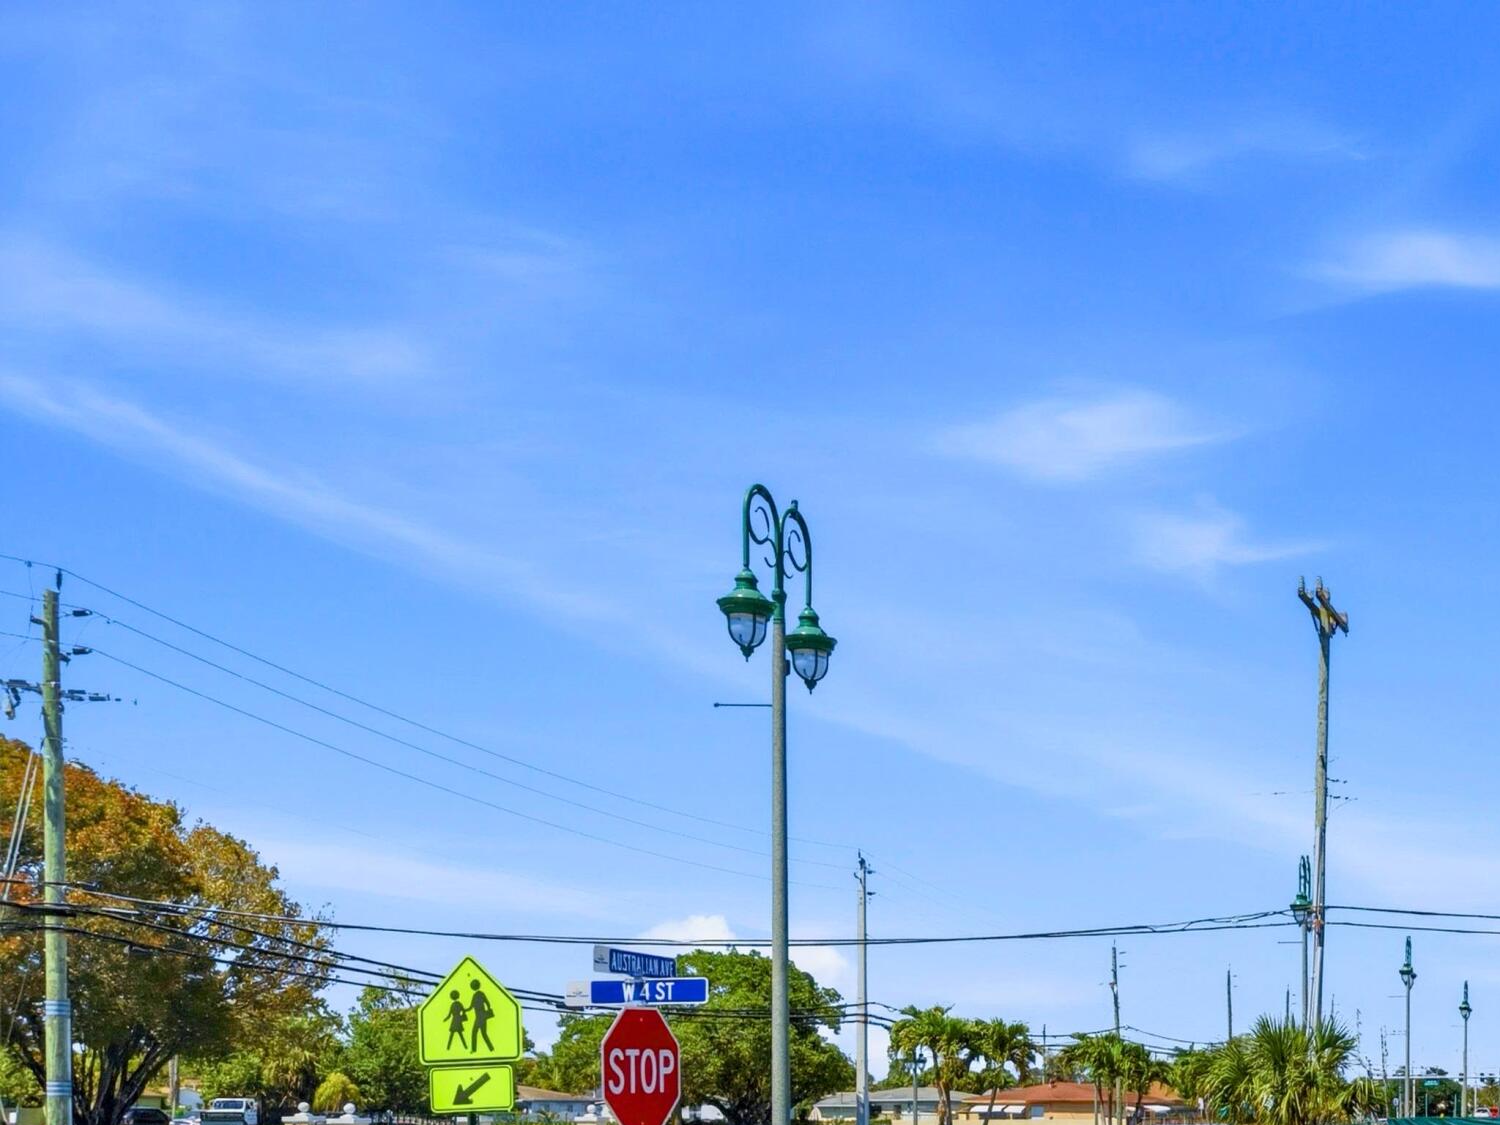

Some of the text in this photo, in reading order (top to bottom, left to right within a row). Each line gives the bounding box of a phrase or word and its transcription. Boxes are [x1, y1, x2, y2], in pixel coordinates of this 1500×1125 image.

[611, 951, 674, 978] AUSTRALIAN AVE
[622, 981, 676, 1002] W 4 ST
[608, 1047, 675, 1095] STOP
